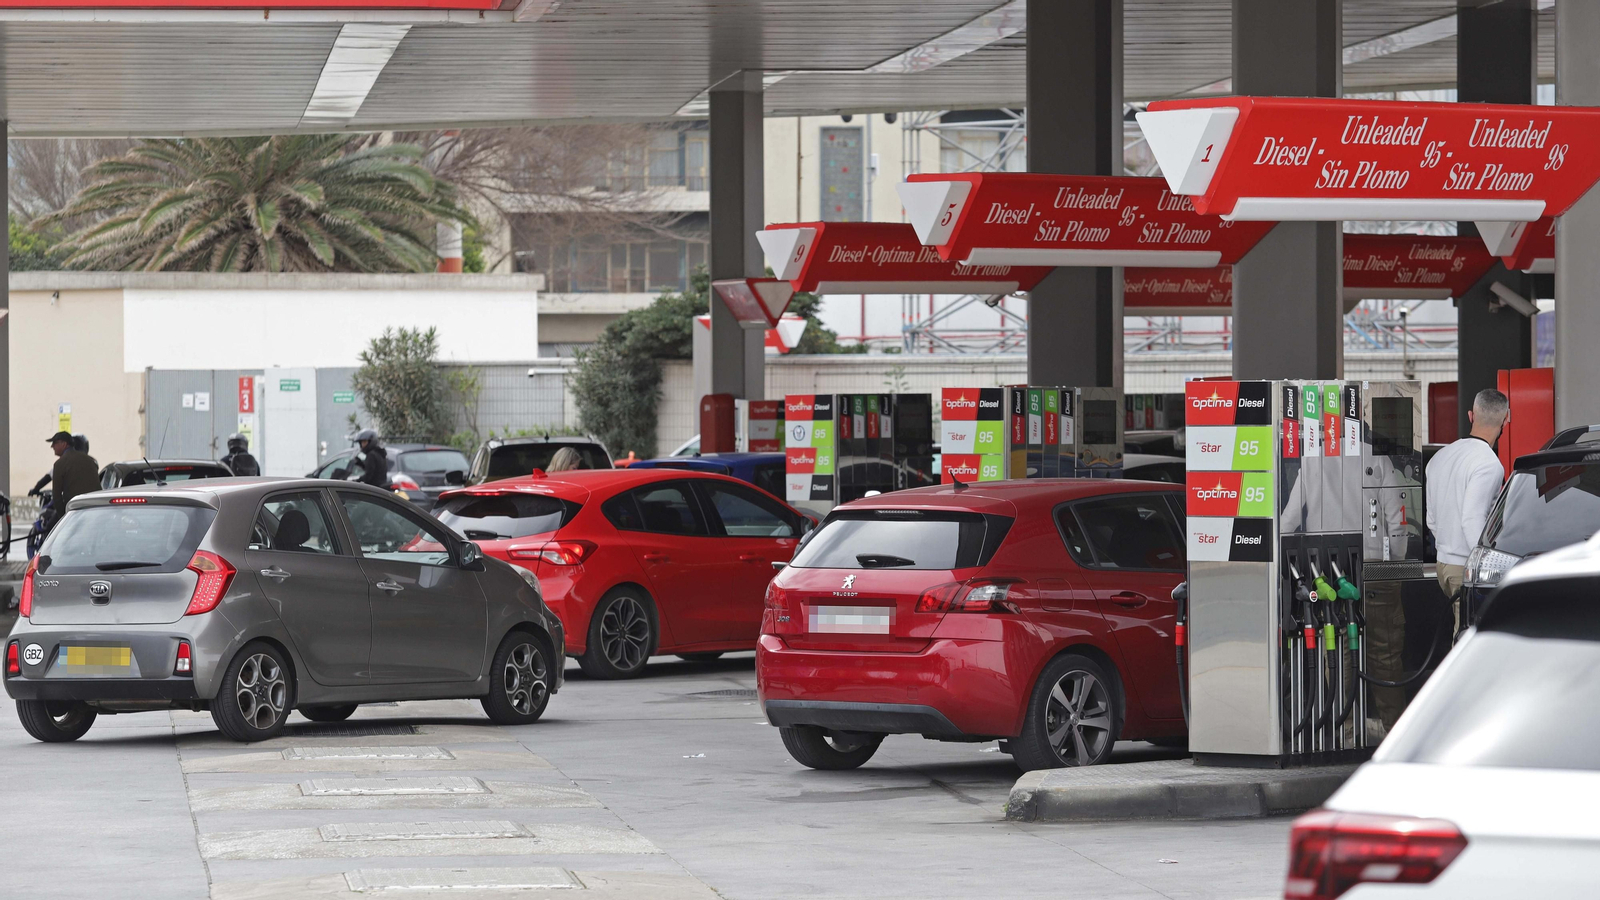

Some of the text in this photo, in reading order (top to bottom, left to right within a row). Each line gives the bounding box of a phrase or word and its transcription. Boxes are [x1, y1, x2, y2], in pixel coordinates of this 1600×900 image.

[1340, 115, 1428, 147] Unleaded
[1468, 118, 1553, 150] Unleaded
[1201, 144, 1214, 163] 1
[1253, 136, 1316, 167] Diesel
[1544, 143, 1569, 172] 98
[1314, 160, 1411, 190] Sin Plomo
[1442, 162, 1535, 192] Sin Plomo
[1053, 186, 1125, 210] Unleaded
[1157, 189, 1196, 212] Unlea
[940, 203, 957, 227] 5
[984, 202, 1035, 225] Diesel
[1033, 219, 1111, 243] Sin Plomo
[1137, 222, 1212, 244] Sin Plomo
[794, 244, 806, 263] 9
[1408, 243, 1457, 260] Unleaded
[1450, 256, 1466, 272] 95
[1394, 267, 1446, 284] Sin Plomo
[1123, 278, 1144, 293] iesel
[243, 394, 249, 410] 3
[788, 404, 813, 412] optima
[814, 403, 831, 411] Diesel
[946, 399, 999, 409] optima Diesel
[1031, 394, 1039, 412] 95
[1048, 395, 1055, 408] 95
[1192, 398, 1265, 410] optima Diesel
[1306, 390, 1316, 414] 95
[1328, 391, 1336, 409] 95
[814, 429, 827, 439] 95
[951, 431, 994, 443] star 95
[1200, 440, 1259, 456] star 95
[790, 456, 830, 466] optima 95
[948, 465, 998, 478] optima 95
[1197, 487, 1265, 503] optima 95
[1400, 505, 1409, 526] 1
[1198, 533, 1262, 545] star Diesel
[25, 648, 42, 660] GBZ
